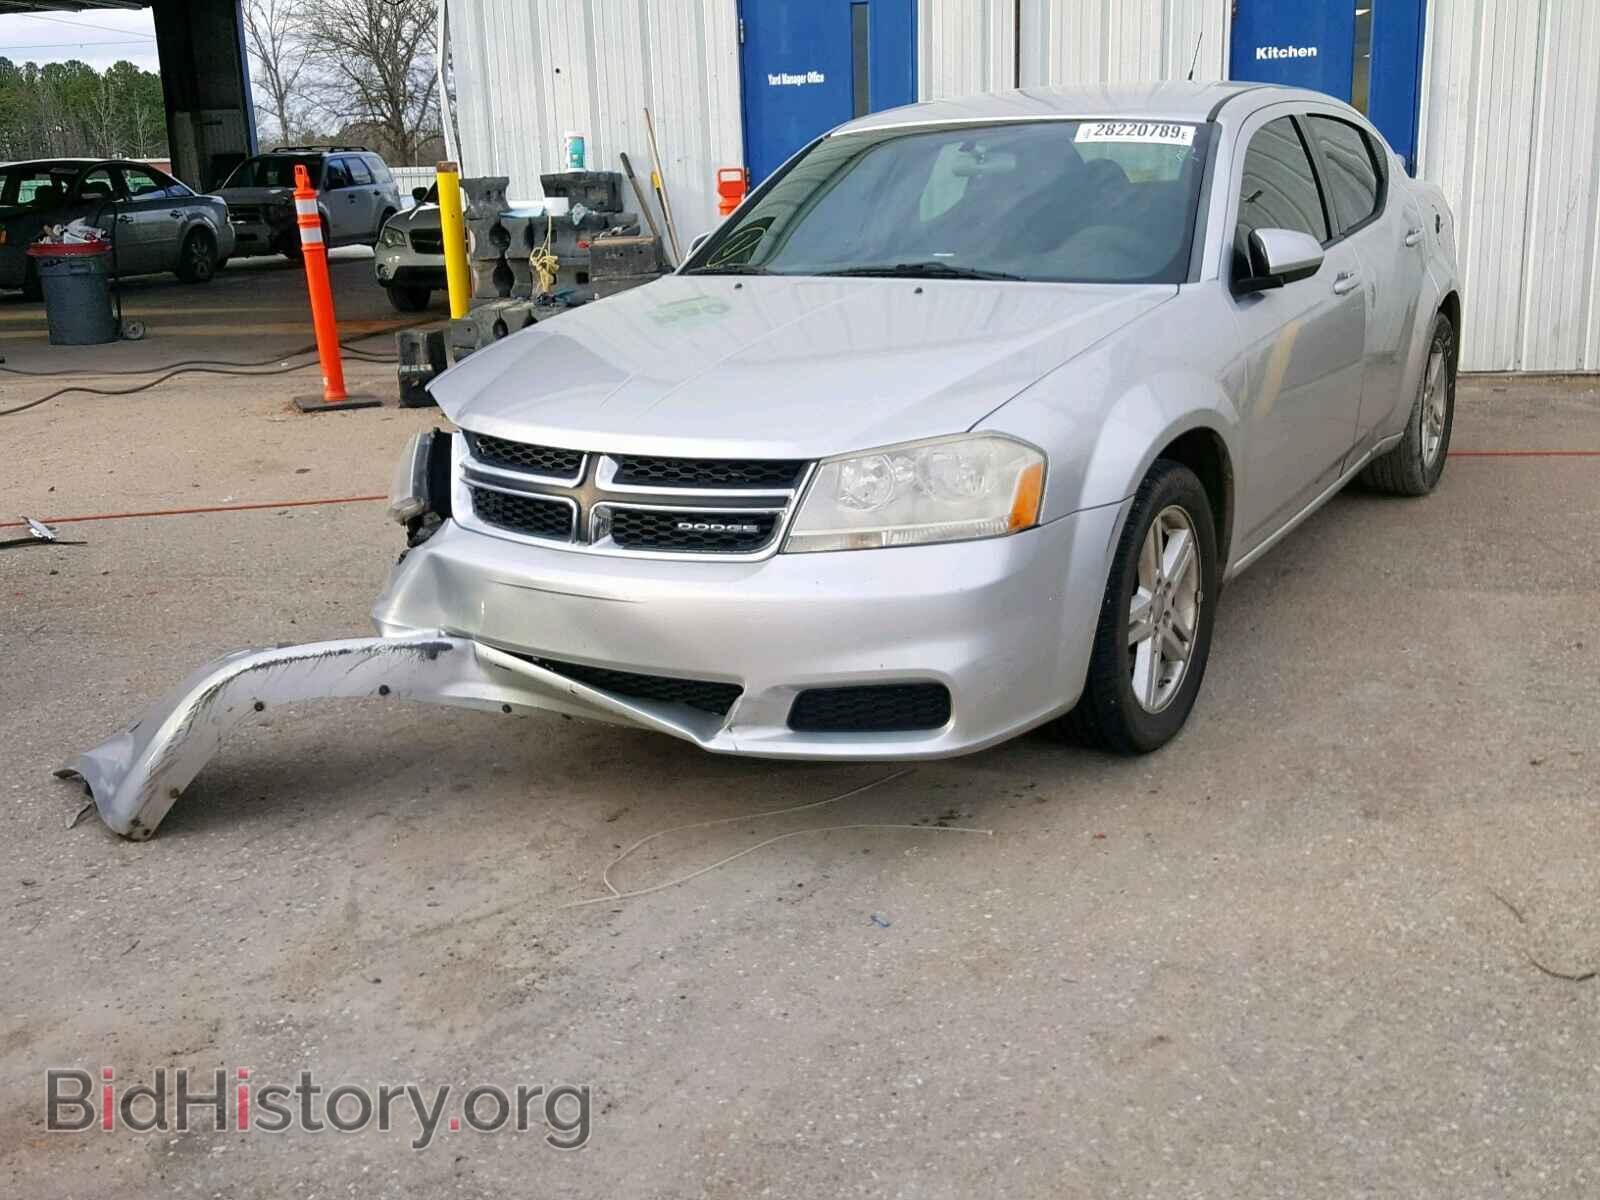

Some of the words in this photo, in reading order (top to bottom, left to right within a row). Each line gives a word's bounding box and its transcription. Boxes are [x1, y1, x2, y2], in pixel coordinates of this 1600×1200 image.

[1256, 46, 1318, 60] Kitchen
[768, 73, 780, 86] Yard
[782, 73, 806, 86] Manager
[807, 71, 825, 83] Office
[1094, 123, 1180, 139] 28220789
[678, 523, 758, 533] DODGE
